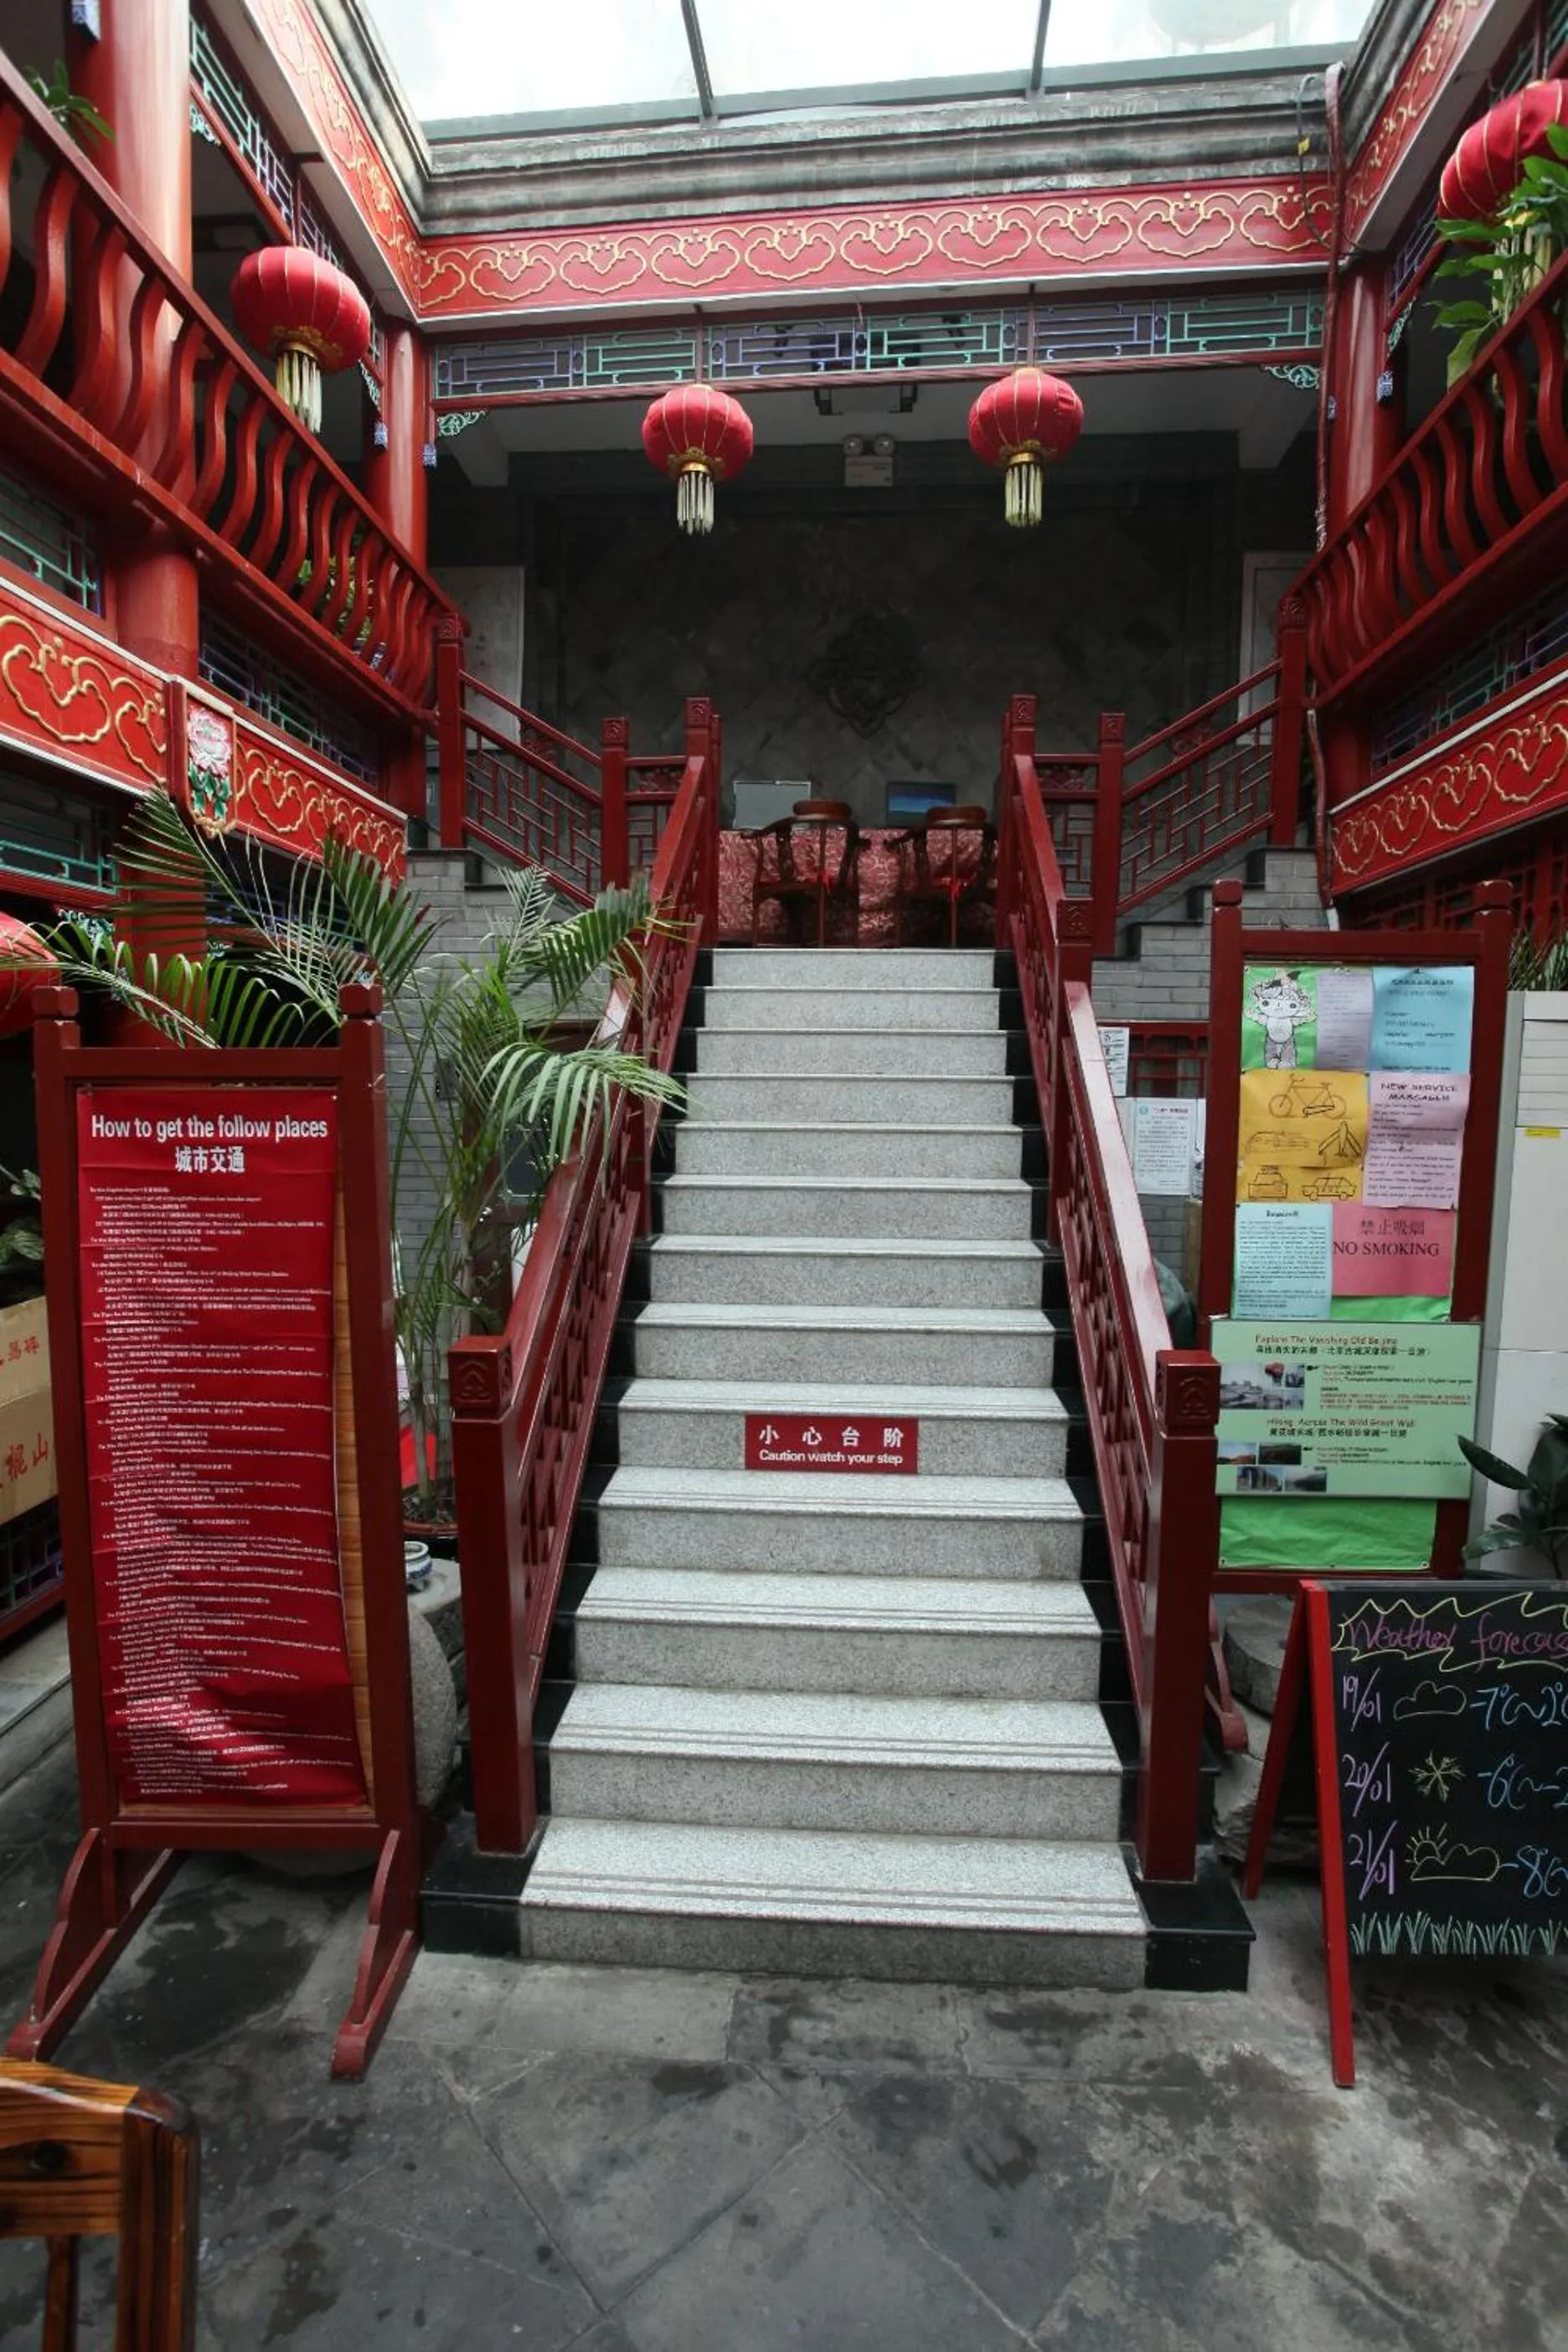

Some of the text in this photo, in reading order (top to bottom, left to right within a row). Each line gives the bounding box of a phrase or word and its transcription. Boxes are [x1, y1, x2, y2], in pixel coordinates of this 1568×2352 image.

[91, 1115, 328, 1142] How to get the follow places
[174, 1145, 245, 1173] 城市交通
[1333, 1241, 1440, 1256] NO SMOKING
[759, 1425, 904, 1447] 小心台阶
[759, 1449, 903, 1466] Caution watch your step
[1344, 1614, 1457, 1650] Weather
[1343, 1668, 1381, 1731] 19/01
[1342, 1741, 1391, 1817] 20/01
[1347, 1819, 1398, 1901] 21/01
